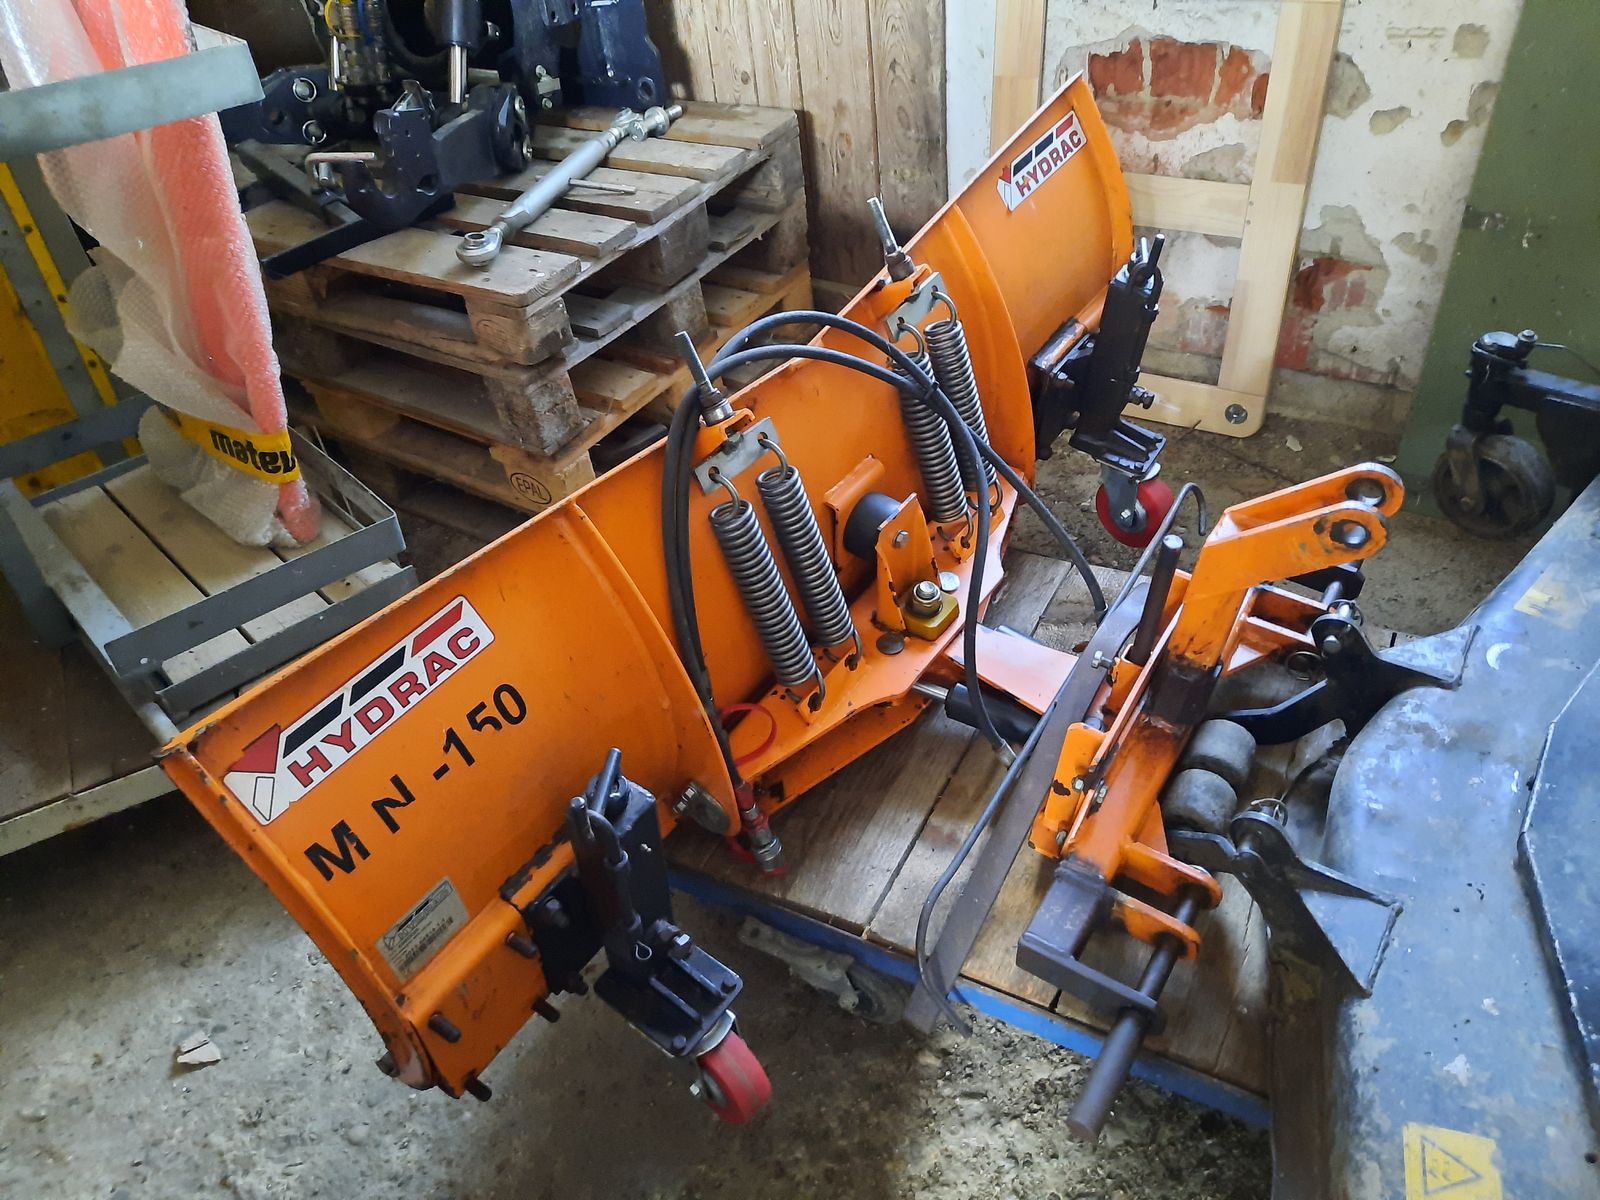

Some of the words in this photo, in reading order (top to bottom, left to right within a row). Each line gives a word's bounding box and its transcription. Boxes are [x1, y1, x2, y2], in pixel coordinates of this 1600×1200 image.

[1015, 130, 1082, 198] HYDRAC
[516, 477, 548, 501] EPAL
[287, 627, 481, 789] HYDRAC
